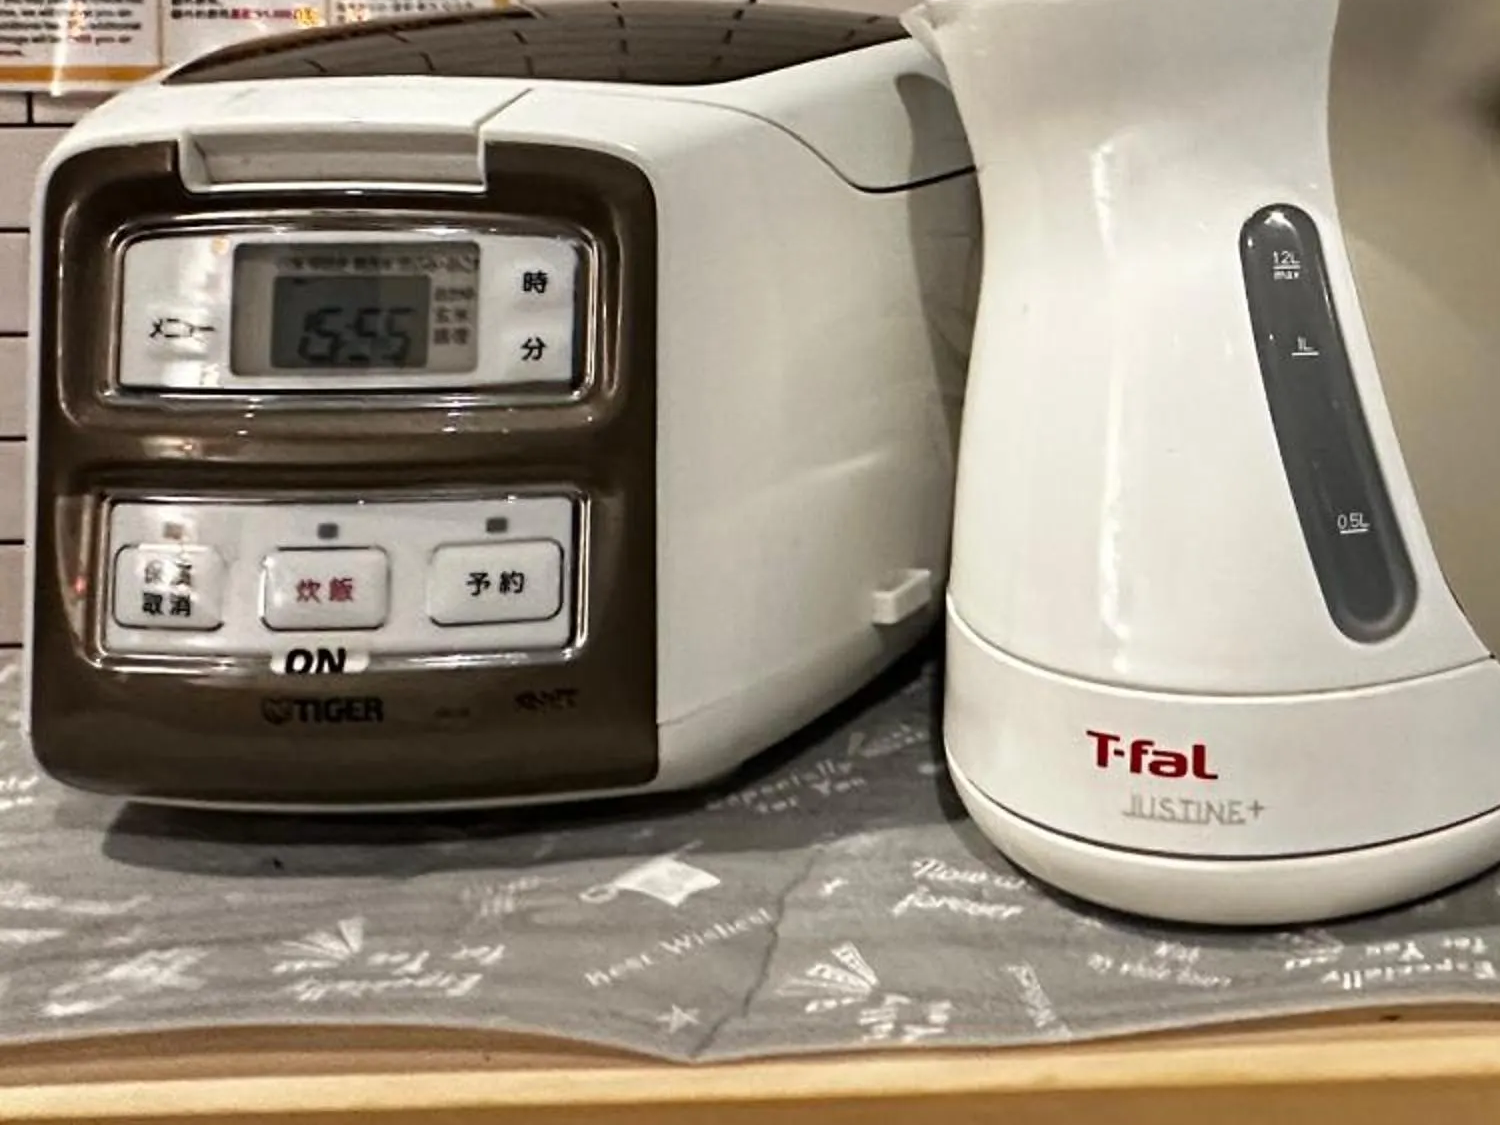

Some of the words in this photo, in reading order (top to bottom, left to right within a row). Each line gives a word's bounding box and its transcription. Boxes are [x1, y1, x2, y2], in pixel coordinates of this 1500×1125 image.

[522, 270, 548, 294] 時
[521, 337, 546, 361] 分
[296, 577, 355, 604] 炊飯
[466, 570, 526, 596] 予約
[142, 592, 192, 618] 取消
[284, 647, 347, 675] ON
[295, 696, 385, 723] TIGER
[1086, 730, 1219, 780] T-fal
